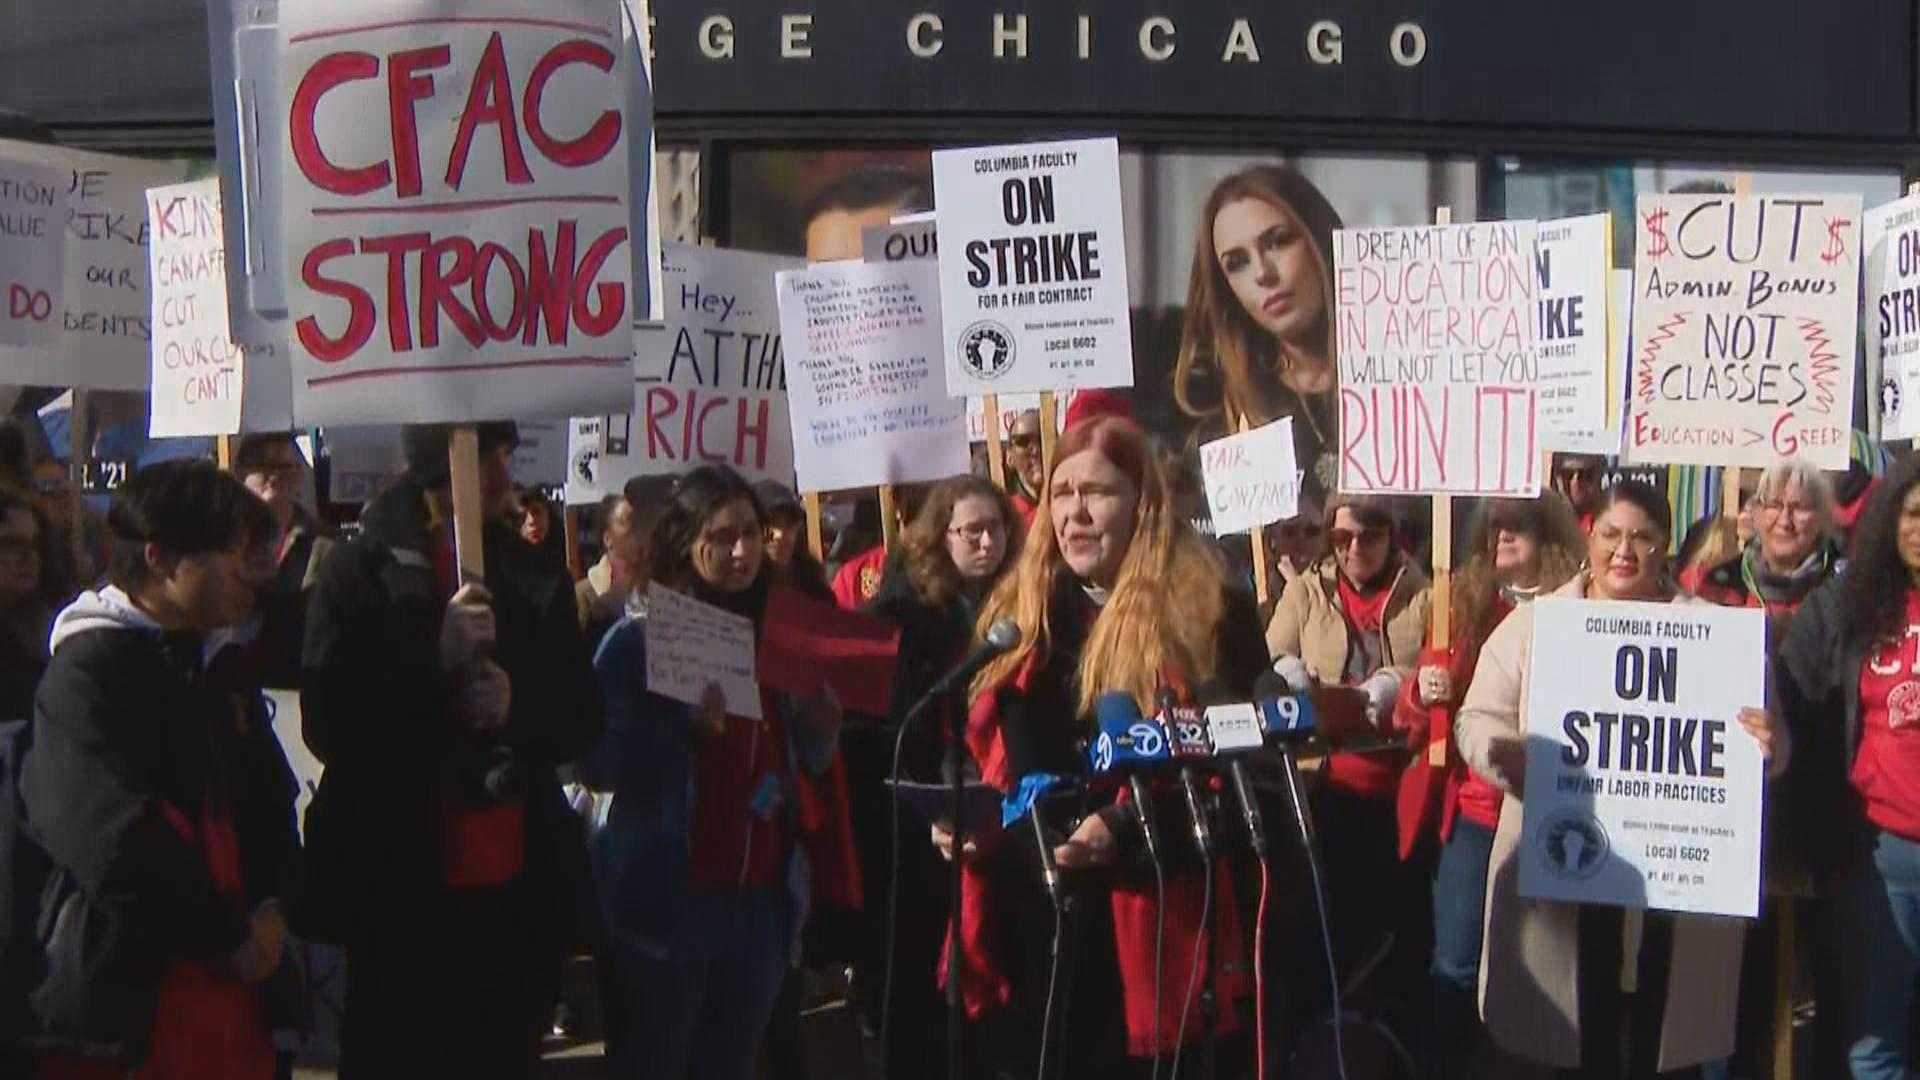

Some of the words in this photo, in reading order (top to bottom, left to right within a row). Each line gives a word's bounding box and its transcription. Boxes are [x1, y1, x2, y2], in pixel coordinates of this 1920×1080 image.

[906, 14, 1429, 67] CHICAGO
[290, 31, 622, 198] CFAC
[974, 157, 1030, 174] COLUMBIA
[1032, 152, 1078, 170] FACULTY
[1002, 175, 1055, 226] ON
[1356, 227, 1448, 262] DREAMT
[1457, 226, 1476, 257] OF
[1488, 226, 1518, 257] AN
[1677, 198, 1823, 264] CUT
[86, 265, 136, 291] OUR
[965, 231, 1101, 289] STRIKE
[9, 282, 52, 321] DO
[296, 219, 629, 362] STRONG
[978, 294, 999, 309] FOR
[1001, 295, 1009, 308] A
[1012, 292, 1035, 306] FAIR
[1038, 287, 1093, 304] CONTRACT
[1338, 257, 1531, 306] EDUCATION
[1746, 269, 1838, 310] BONUS
[162, 295, 197, 328] CUT
[1339, 308, 1367, 352] IN
[1384, 304, 1535, 351] AMERICA!
[164, 341, 208, 369] OUR
[1045, 339, 1070, 352] Local
[1704, 313, 1785, 361] NOT
[1351, 354, 1393, 384] WILL
[1397, 354, 1438, 385] NOT
[1450, 352, 1486, 383] LET
[1499, 351, 1538, 383] YOU
[1660, 363, 1807, 407] CLASSES
[646, 387, 769, 471] RICH
[1340, 382, 1449, 492] RUIN
[1475, 385, 1537, 493] IT!
[1634, 411, 1734, 447] EDUCATION
[1772, 412, 1842, 456] GREED
[1586, 617, 1651, 636] COLUMBIA
[1656, 620, 1712, 641] FACULTY
[1614, 644, 1678, 704] ON
[1175, 722, 1204, 745] 32
[1276, 696, 1300, 730] 9
[1561, 710, 1726, 778] STRIKE
[1607, 780, 1650, 799] LABOR
[1654, 783, 1727, 805] PRACTICES
[1645, 843, 1677, 859] Local
[1680, 845, 1710, 863] 6602
